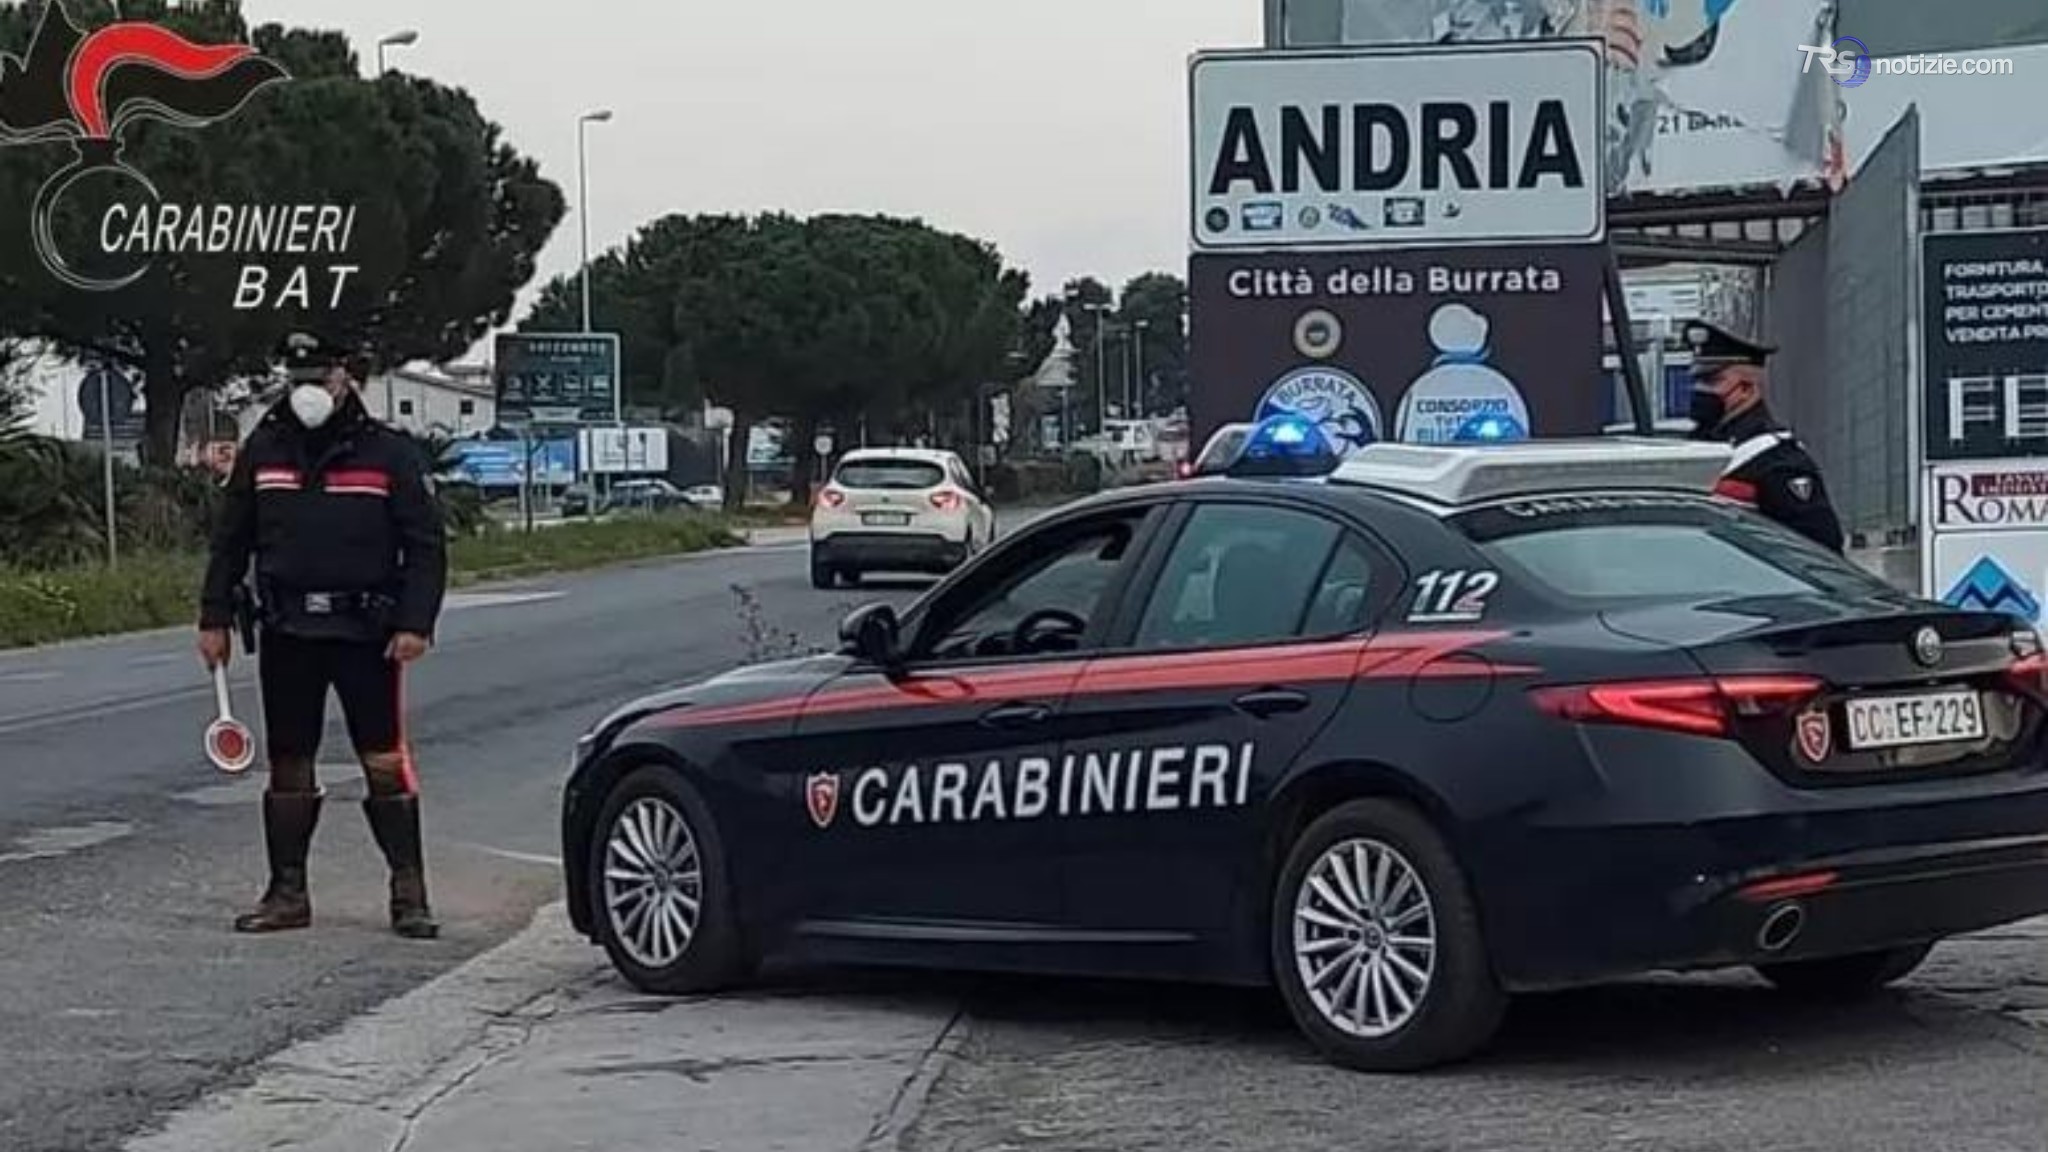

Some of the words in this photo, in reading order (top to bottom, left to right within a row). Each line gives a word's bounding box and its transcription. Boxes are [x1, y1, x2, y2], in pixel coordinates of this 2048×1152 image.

[1208, 100, 1584, 194] ANDRIA
[1229, 269, 1313, 296] Città
[1327, 266, 1413, 294] della
[1428, 266, 1560, 292] Burrata
[1277, 376, 1357, 406] BURRATA
[1410, 570, 1498, 612] 112
[852, 742, 1254, 826] CARABINIERI
